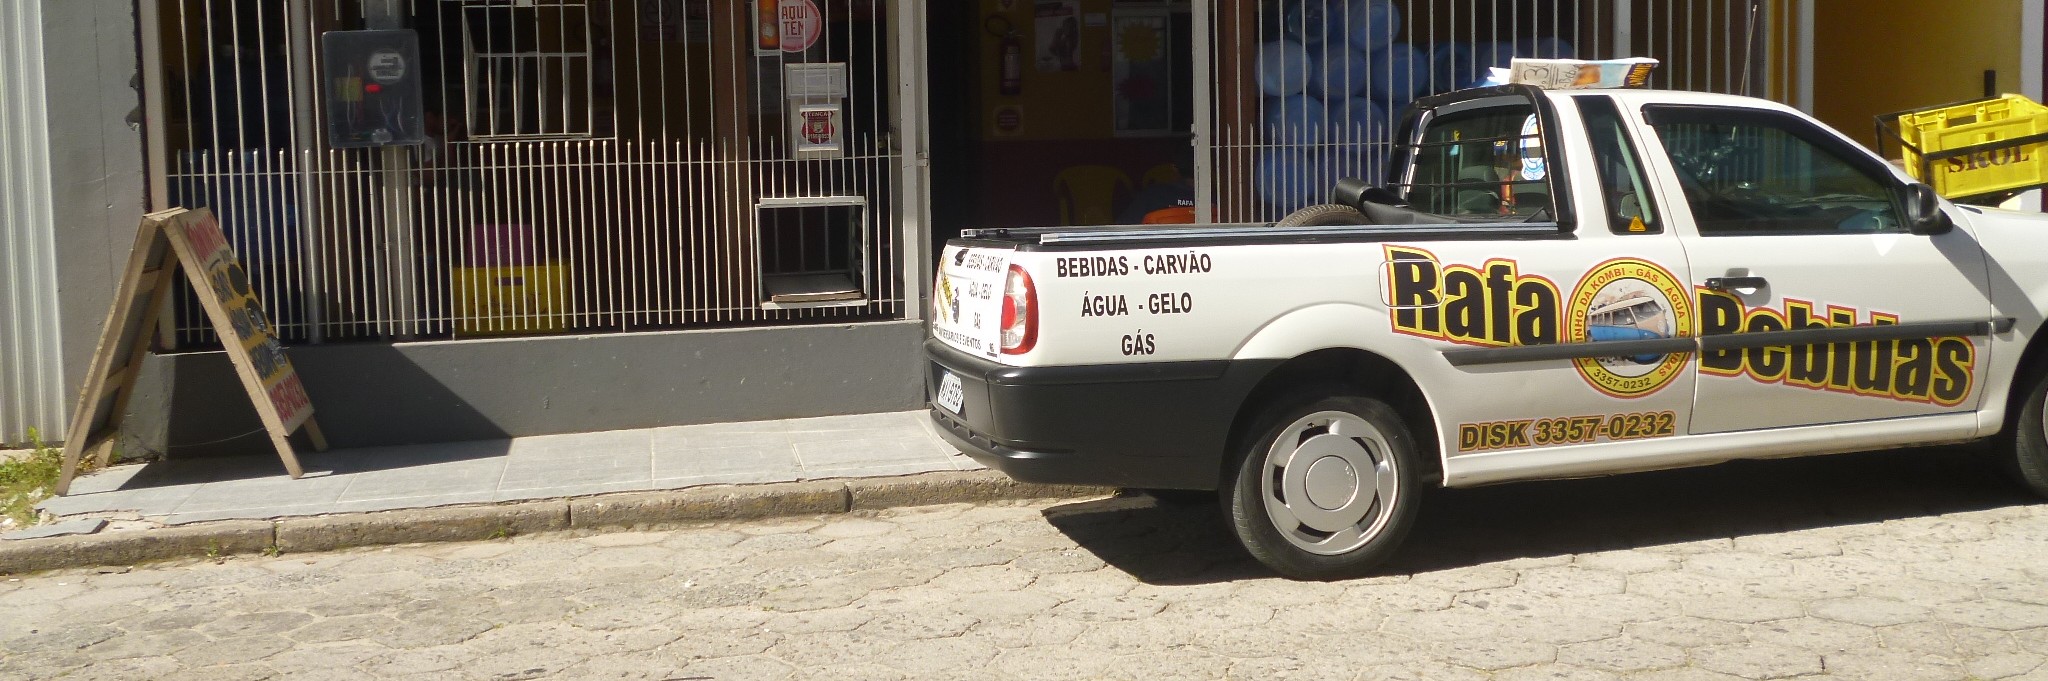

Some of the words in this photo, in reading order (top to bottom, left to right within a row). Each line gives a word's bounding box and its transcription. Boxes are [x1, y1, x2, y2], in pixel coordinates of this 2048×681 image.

[781, 5, 808, 20] AQUI
[1947, 146, 2030, 173] SKOL
[1056, 255, 1129, 278] BEBIDAS
[1143, 250, 1212, 275] CARVÃO
[1081, 290, 1129, 317] ÁGUA
[1148, 292, 1193, 315] GELO
[1579, 291, 1593, 307] DA
[1590, 267, 1625, 290] KOMBI
[1636, 267, 1659, 283] GÁS
[1665, 286, 1685, 319] ÁGUA
[1385, 246, 1560, 346] Rafa
[1697, 288, 1973, 405] Bebidas
[1121, 328, 1156, 356] GÁS
[1594, 369, 1652, 389] 3357-0232
[1460, 422, 1532, 450] DISK
[1533, 412, 1675, 445] 3357-0232
